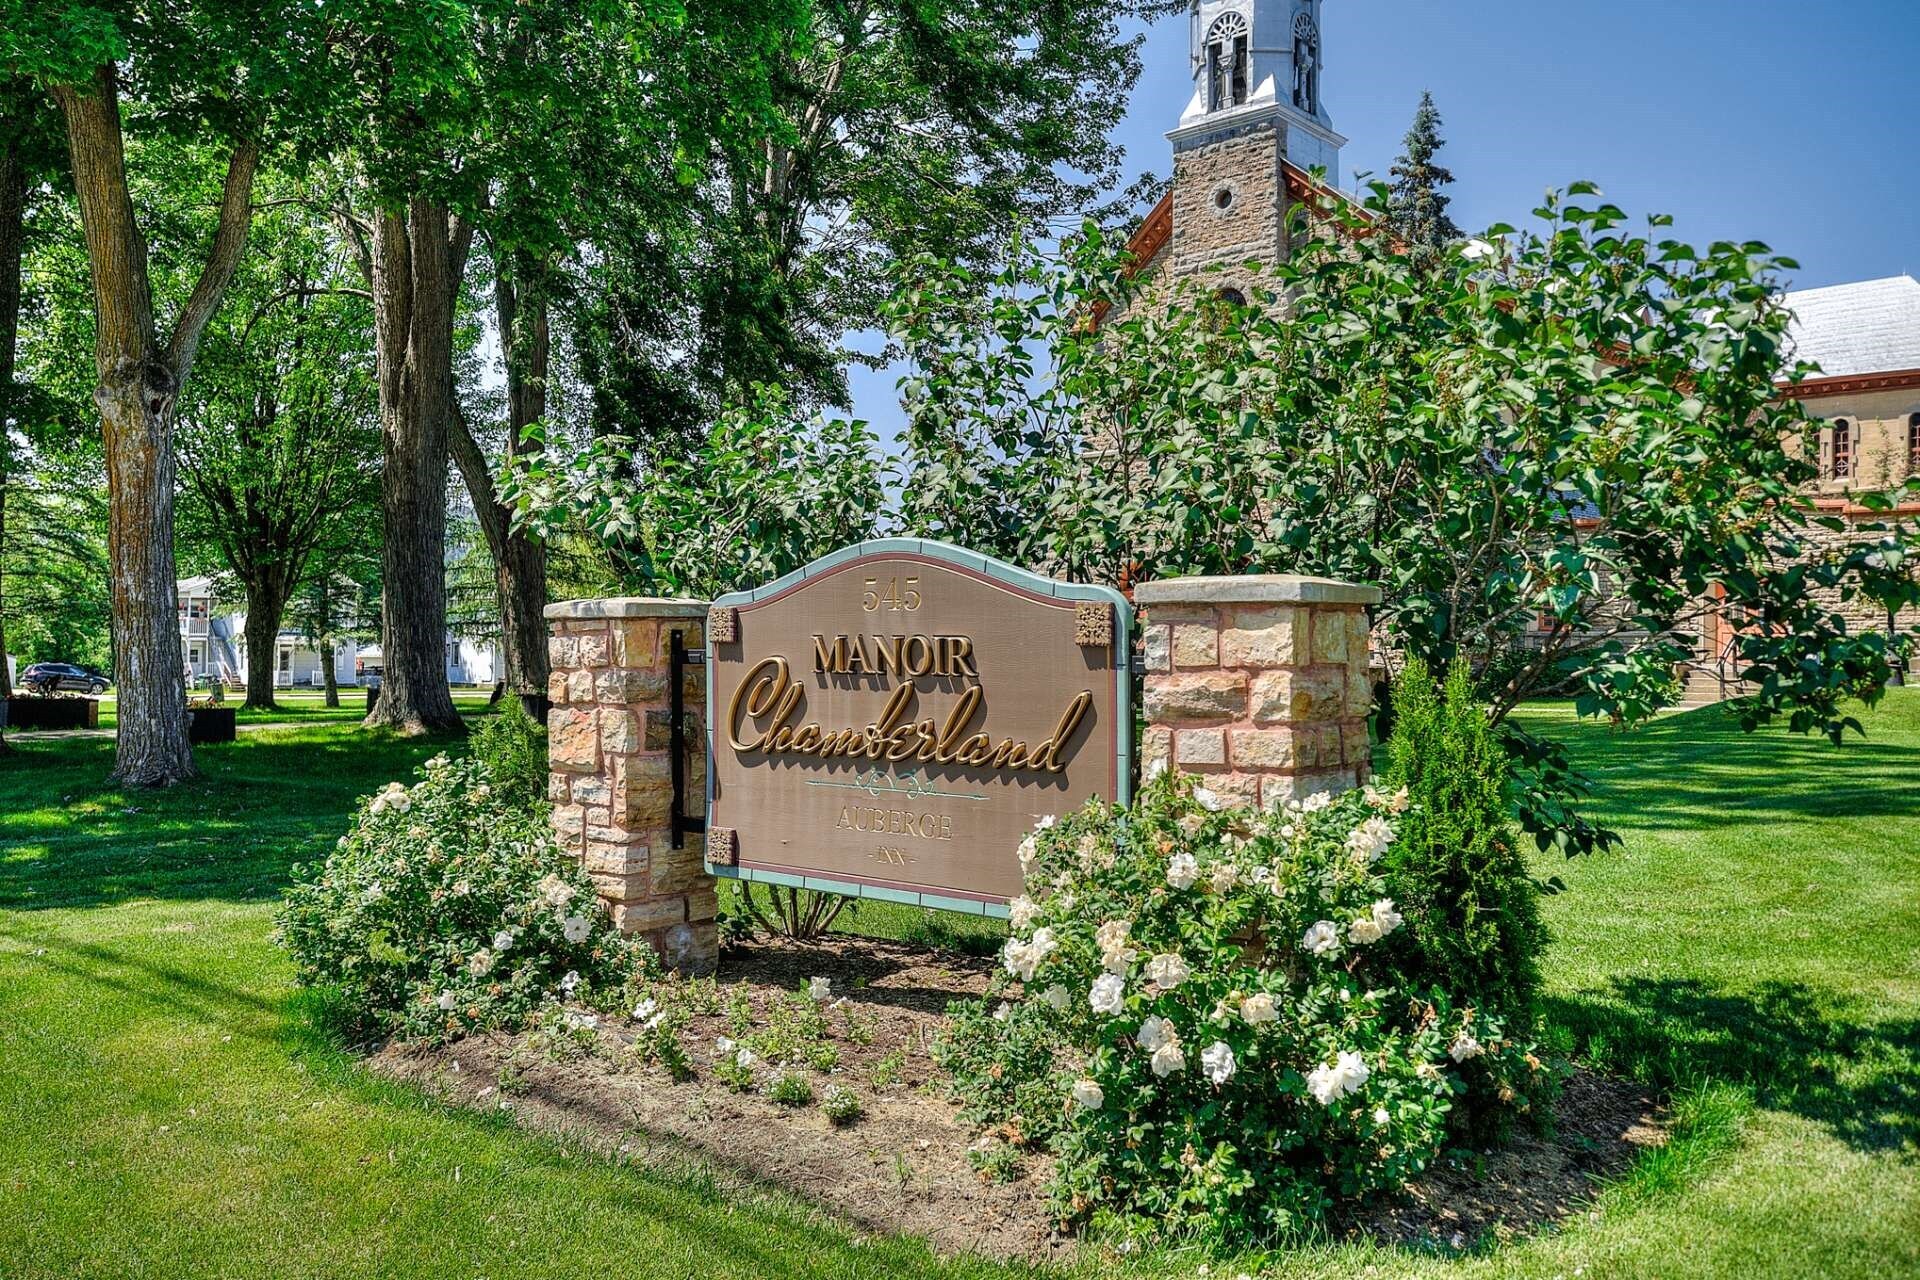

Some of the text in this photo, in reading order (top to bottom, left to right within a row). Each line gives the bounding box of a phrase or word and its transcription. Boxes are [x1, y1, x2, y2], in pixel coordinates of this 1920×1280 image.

[862, 577, 922, 612] 545
[811, 634, 979, 678] MANOIR
[727, 654, 1093, 774] Chamberland
[835, 805, 953, 841] AUBERGE
